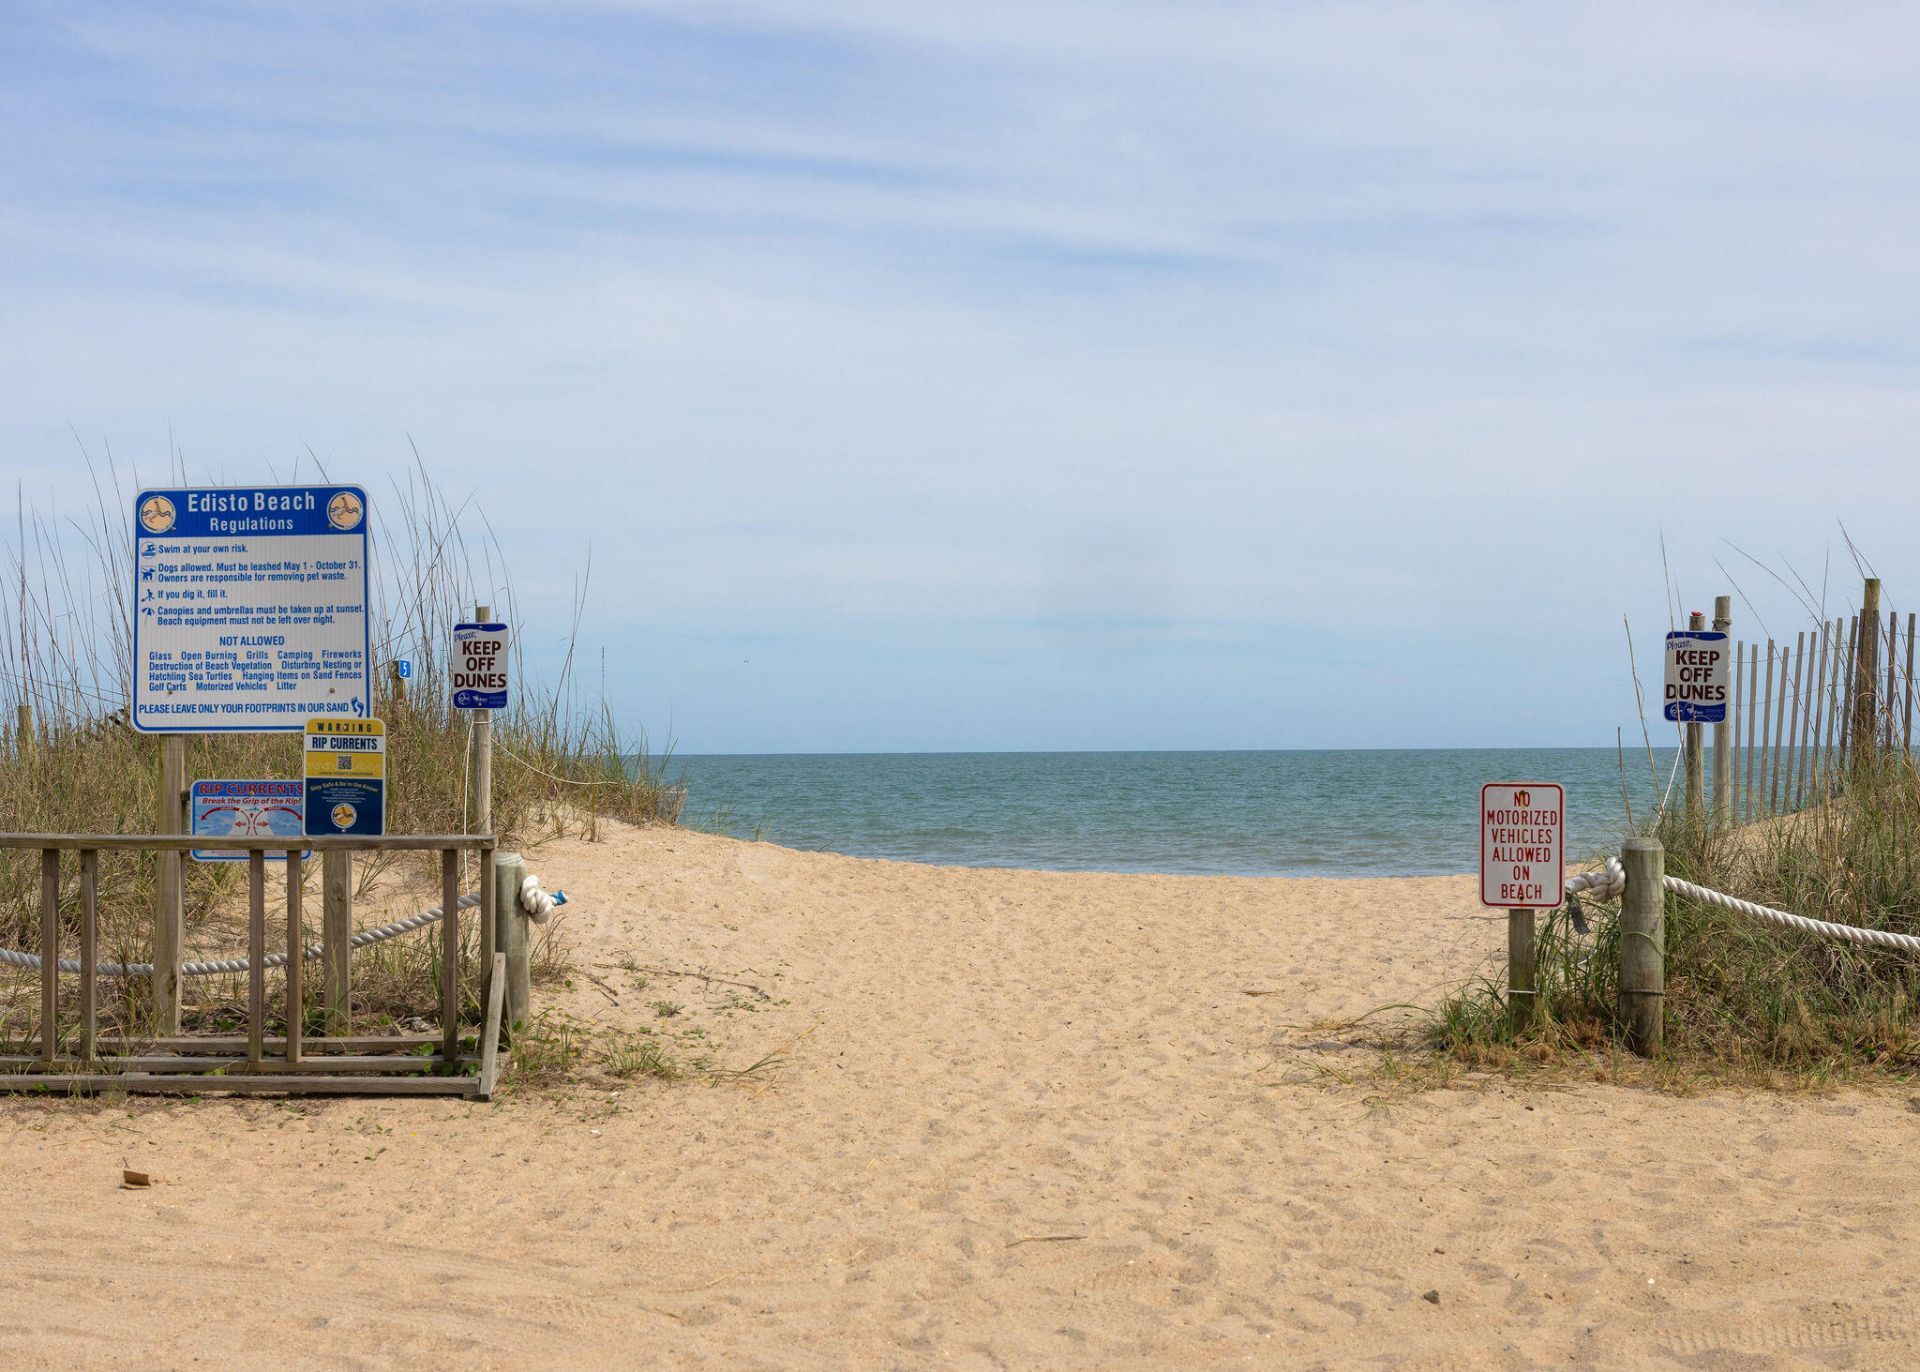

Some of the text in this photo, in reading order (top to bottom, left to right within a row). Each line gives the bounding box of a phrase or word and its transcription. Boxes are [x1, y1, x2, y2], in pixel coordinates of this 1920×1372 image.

[188, 491, 315, 512] Edisto Beach
[210, 517, 294, 534] Regulations
[158, 545, 180, 553] Swim
[183, 545, 190, 553] at
[193, 546, 210, 555] your
[158, 563, 178, 573] Dogs
[216, 563, 236, 571] Must
[239, 562, 248, 571] be
[250, 562, 280, 571] leashed
[284, 562, 300, 572] May
[316, 561, 346, 570] October
[158, 574, 187, 582] Owners
[206, 573, 252, 583] responsible
[268, 573, 304, 582] removing
[307, 573, 319, 582] pet
[158, 590, 164, 598] If
[166, 592, 180, 600] you
[182, 590, 194, 600] dig
[208, 590, 218, 598] fill
[158, 606, 194, 616] Canopies
[197, 606, 212, 614] and
[214, 606, 254, 614] umbrellas
[256, 606, 276, 614] must
[278, 606, 288, 614] be
[314, 606, 324, 614] up
[158, 617, 182, 626] Beach
[185, 617, 227, 626] equipment
[220, 636, 284, 646] NOT ALLOWED
[462, 641, 501, 655] KEEP
[150, 650, 362, 661] Glass Open Burning Grills Camping Fireworks
[1676, 650, 1720, 666] KEEP
[150, 662, 193, 670] Destruction
[196, 662, 203, 670] of
[206, 662, 229, 670] Beach
[232, 661, 272, 671] Vegetation
[282, 661, 320, 670] Disturbing
[323, 661, 351, 670] Nesting
[466, 657, 496, 671] OFF
[150, 672, 186, 682] Hatchling
[188, 672, 203, 680] Sea
[206, 672, 232, 680] Turtles
[243, 672, 274, 681] Hanging
[314, 671, 332, 679] Sand
[335, 671, 362, 679] Fences
[454, 673, 506, 688] DUNES
[1680, 667, 1713, 682] OFF
[150, 682, 297, 691] Golf Carts Motorized Vehicles Litter
[1666, 684, 1725, 700] DUNES
[140, 703, 348, 713] PLEASE LEAVE ONLY YOUR FOOTPRINTS IN OUR SAND
[312, 737, 377, 750] RIP CURRENTS
[200, 784, 304, 794] RIP CURRENTS
[242, 798, 258, 806] Grip
[1514, 792, 1530, 807] NO
[1487, 810, 1557, 826] MOTORIZED
[1492, 829, 1552, 844] VEHICLES
[1492, 847, 1550, 862] ALLOWED
[1514, 866, 1530, 880] ON
[1502, 884, 1542, 899] BEACH
